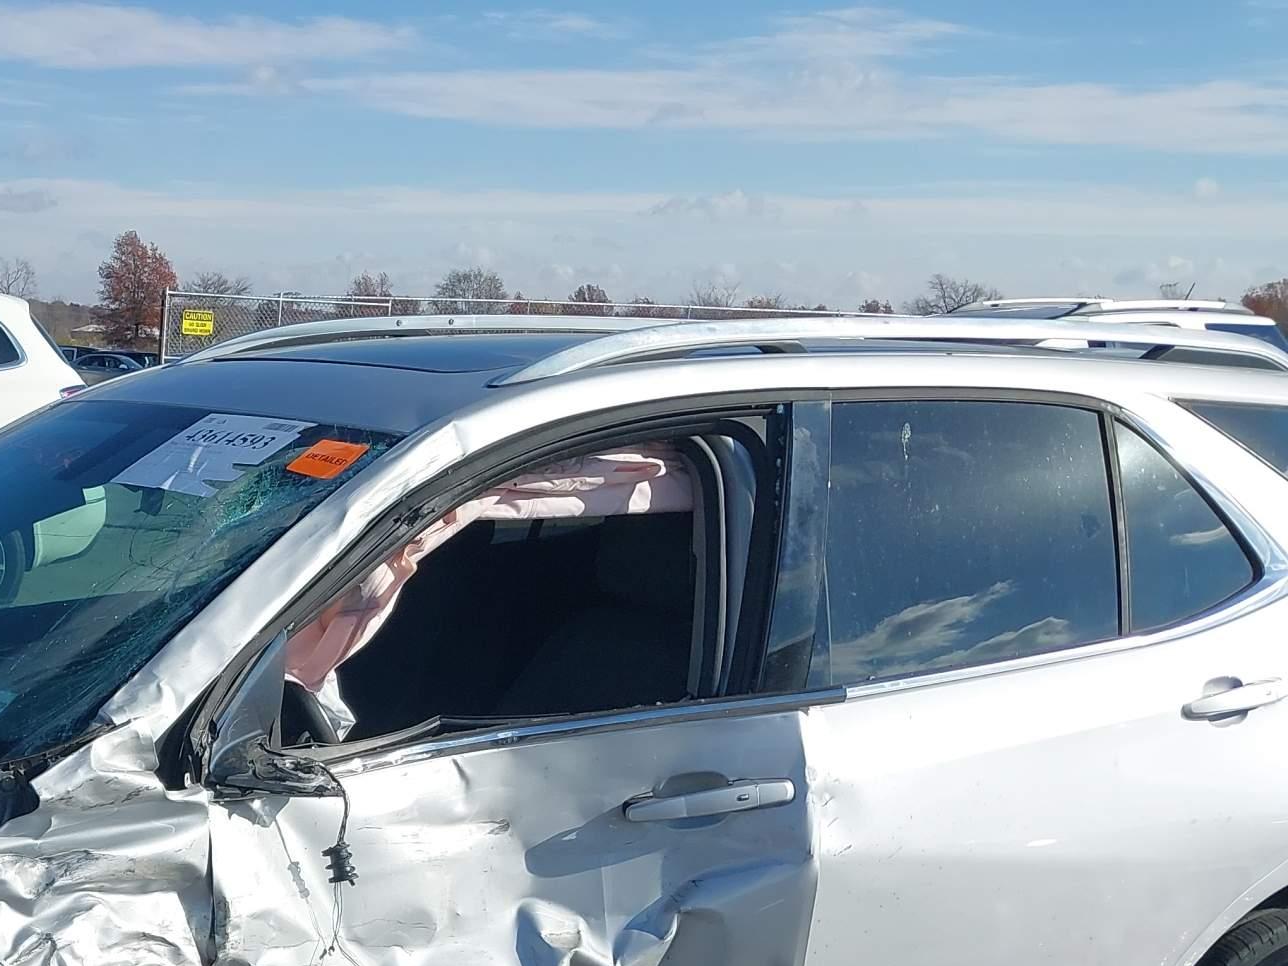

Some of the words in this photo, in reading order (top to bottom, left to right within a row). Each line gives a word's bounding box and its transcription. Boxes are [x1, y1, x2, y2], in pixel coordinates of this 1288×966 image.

[185, 312, 212, 320] CAUTION
[185, 429, 277, 450] 43614593
[305, 452, 348, 466] DETAILED
